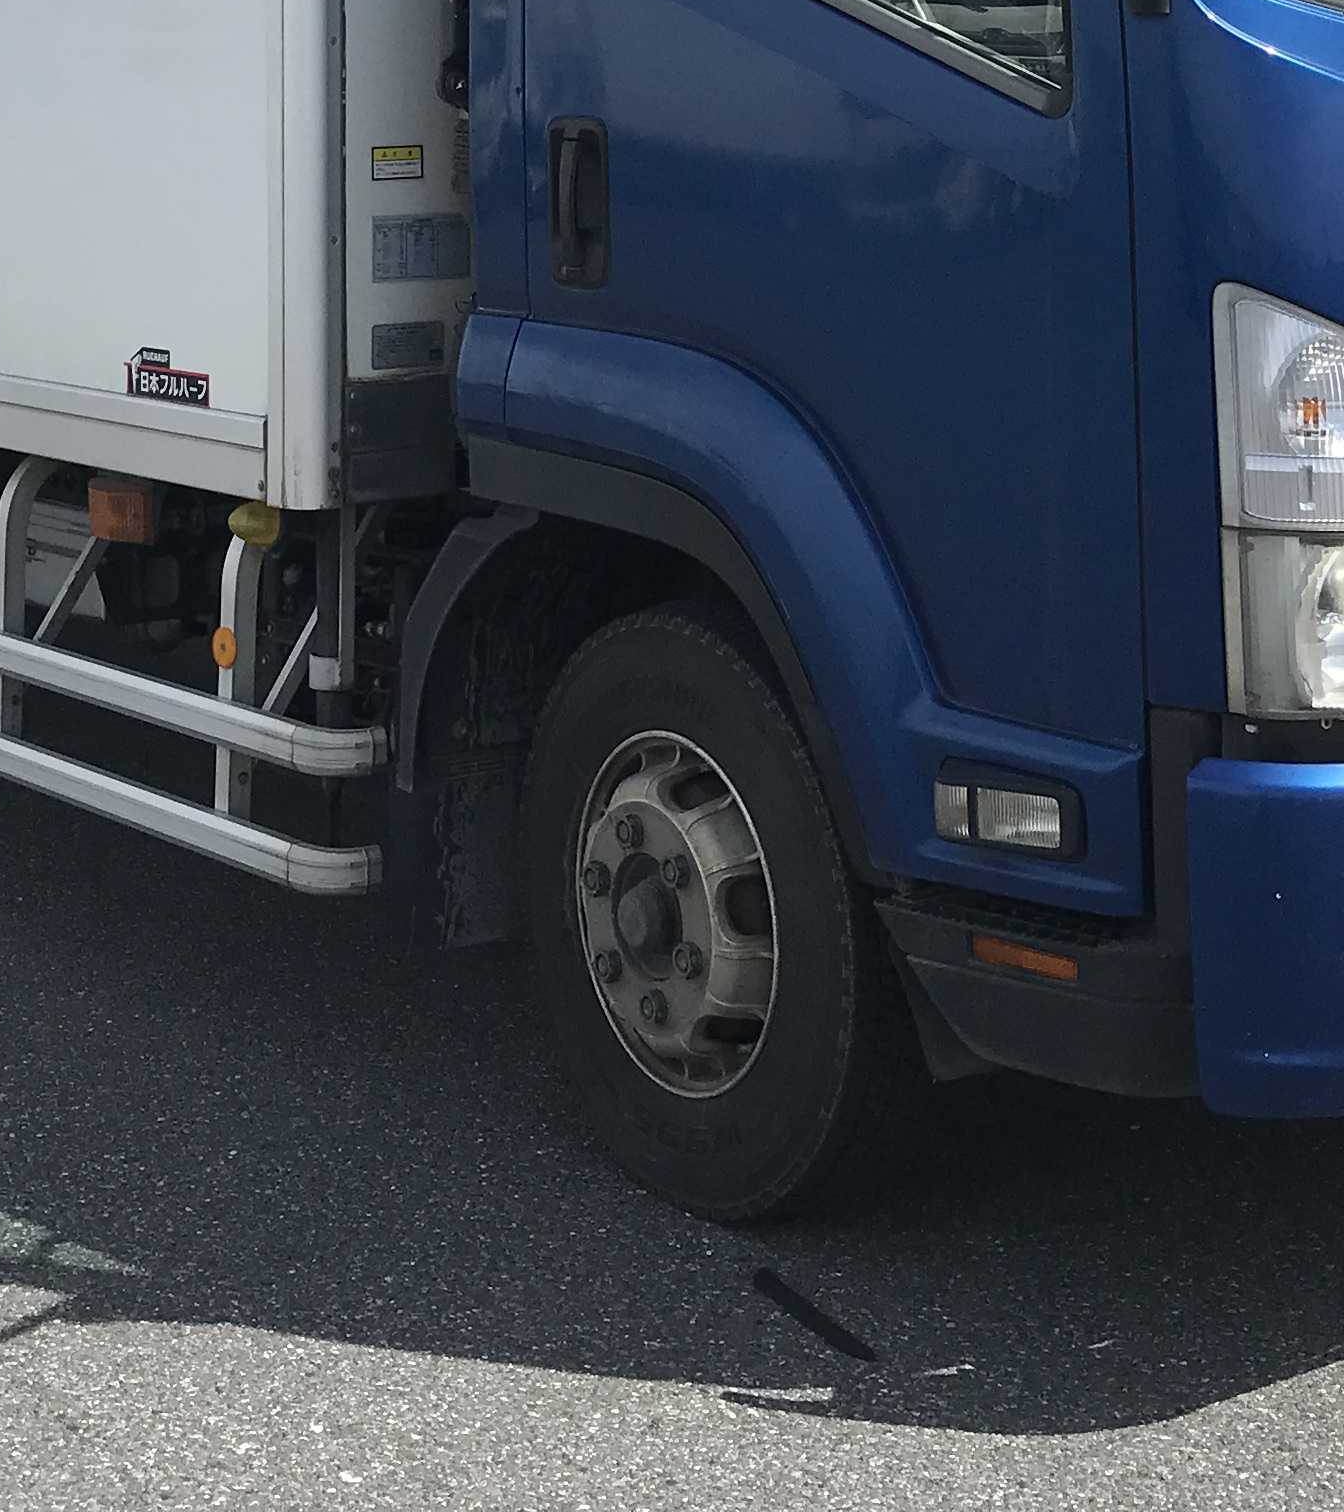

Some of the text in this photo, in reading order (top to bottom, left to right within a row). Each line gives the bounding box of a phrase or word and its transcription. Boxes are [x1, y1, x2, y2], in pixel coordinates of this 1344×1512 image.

[140, 371, 207, 400] 日本フルハーフ
